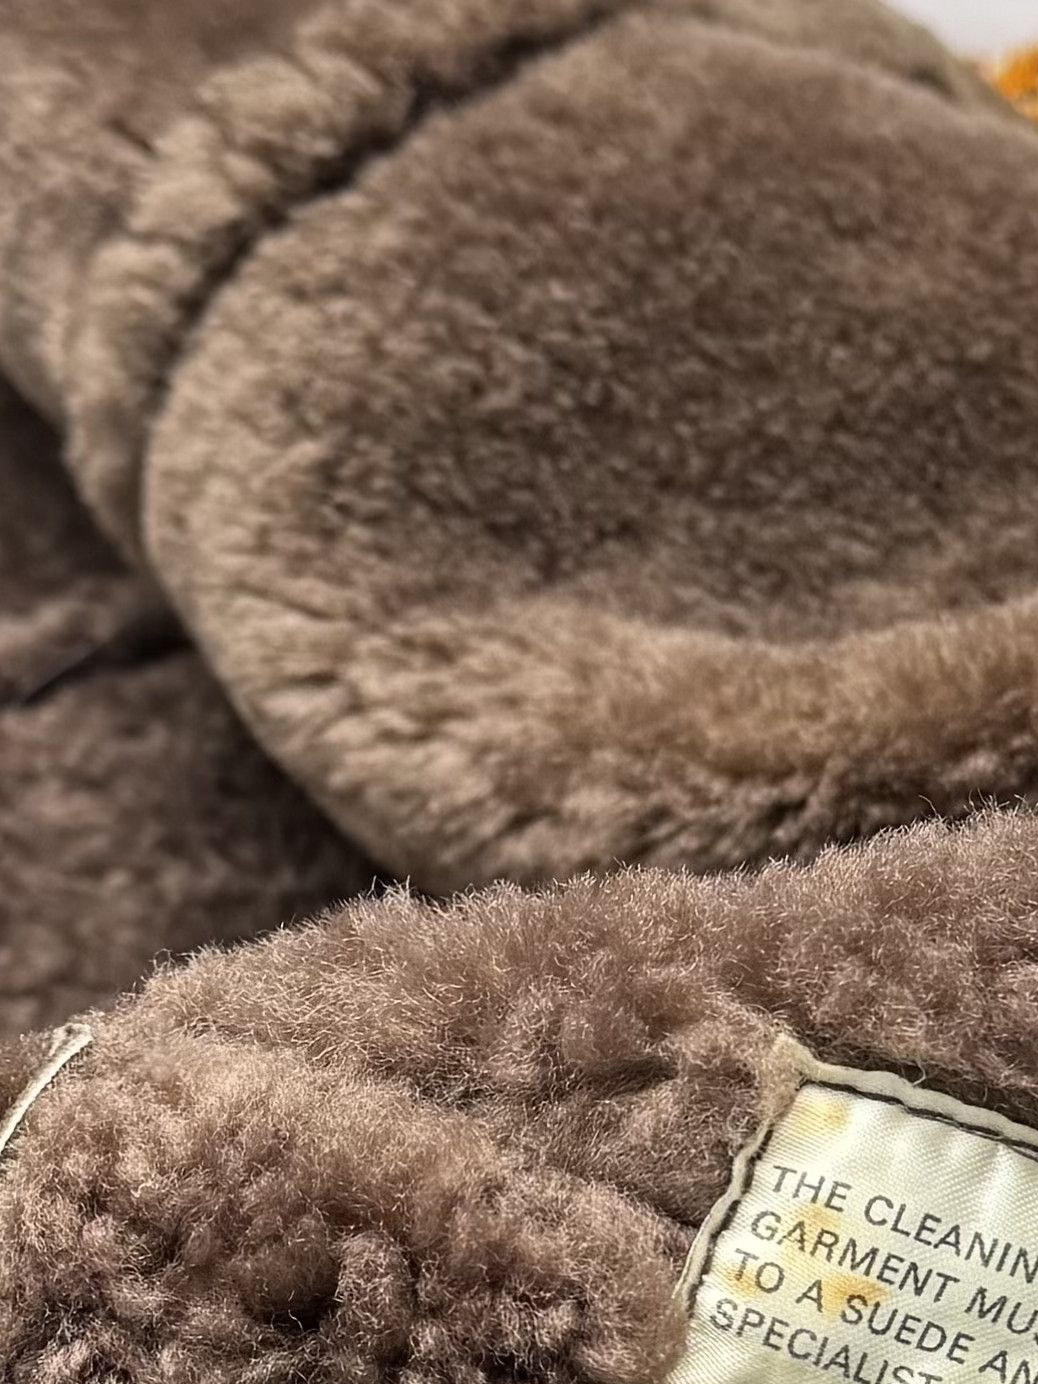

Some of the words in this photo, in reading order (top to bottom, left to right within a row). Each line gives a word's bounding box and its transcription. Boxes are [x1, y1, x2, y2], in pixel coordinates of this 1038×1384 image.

[773, 1165, 852, 1212] THE
[751, 1210, 960, 1303] GARMENT
[734, 1248, 785, 1293] TO
[795, 1279, 824, 1313] A
[840, 1294, 975, 1365] SUEDE
